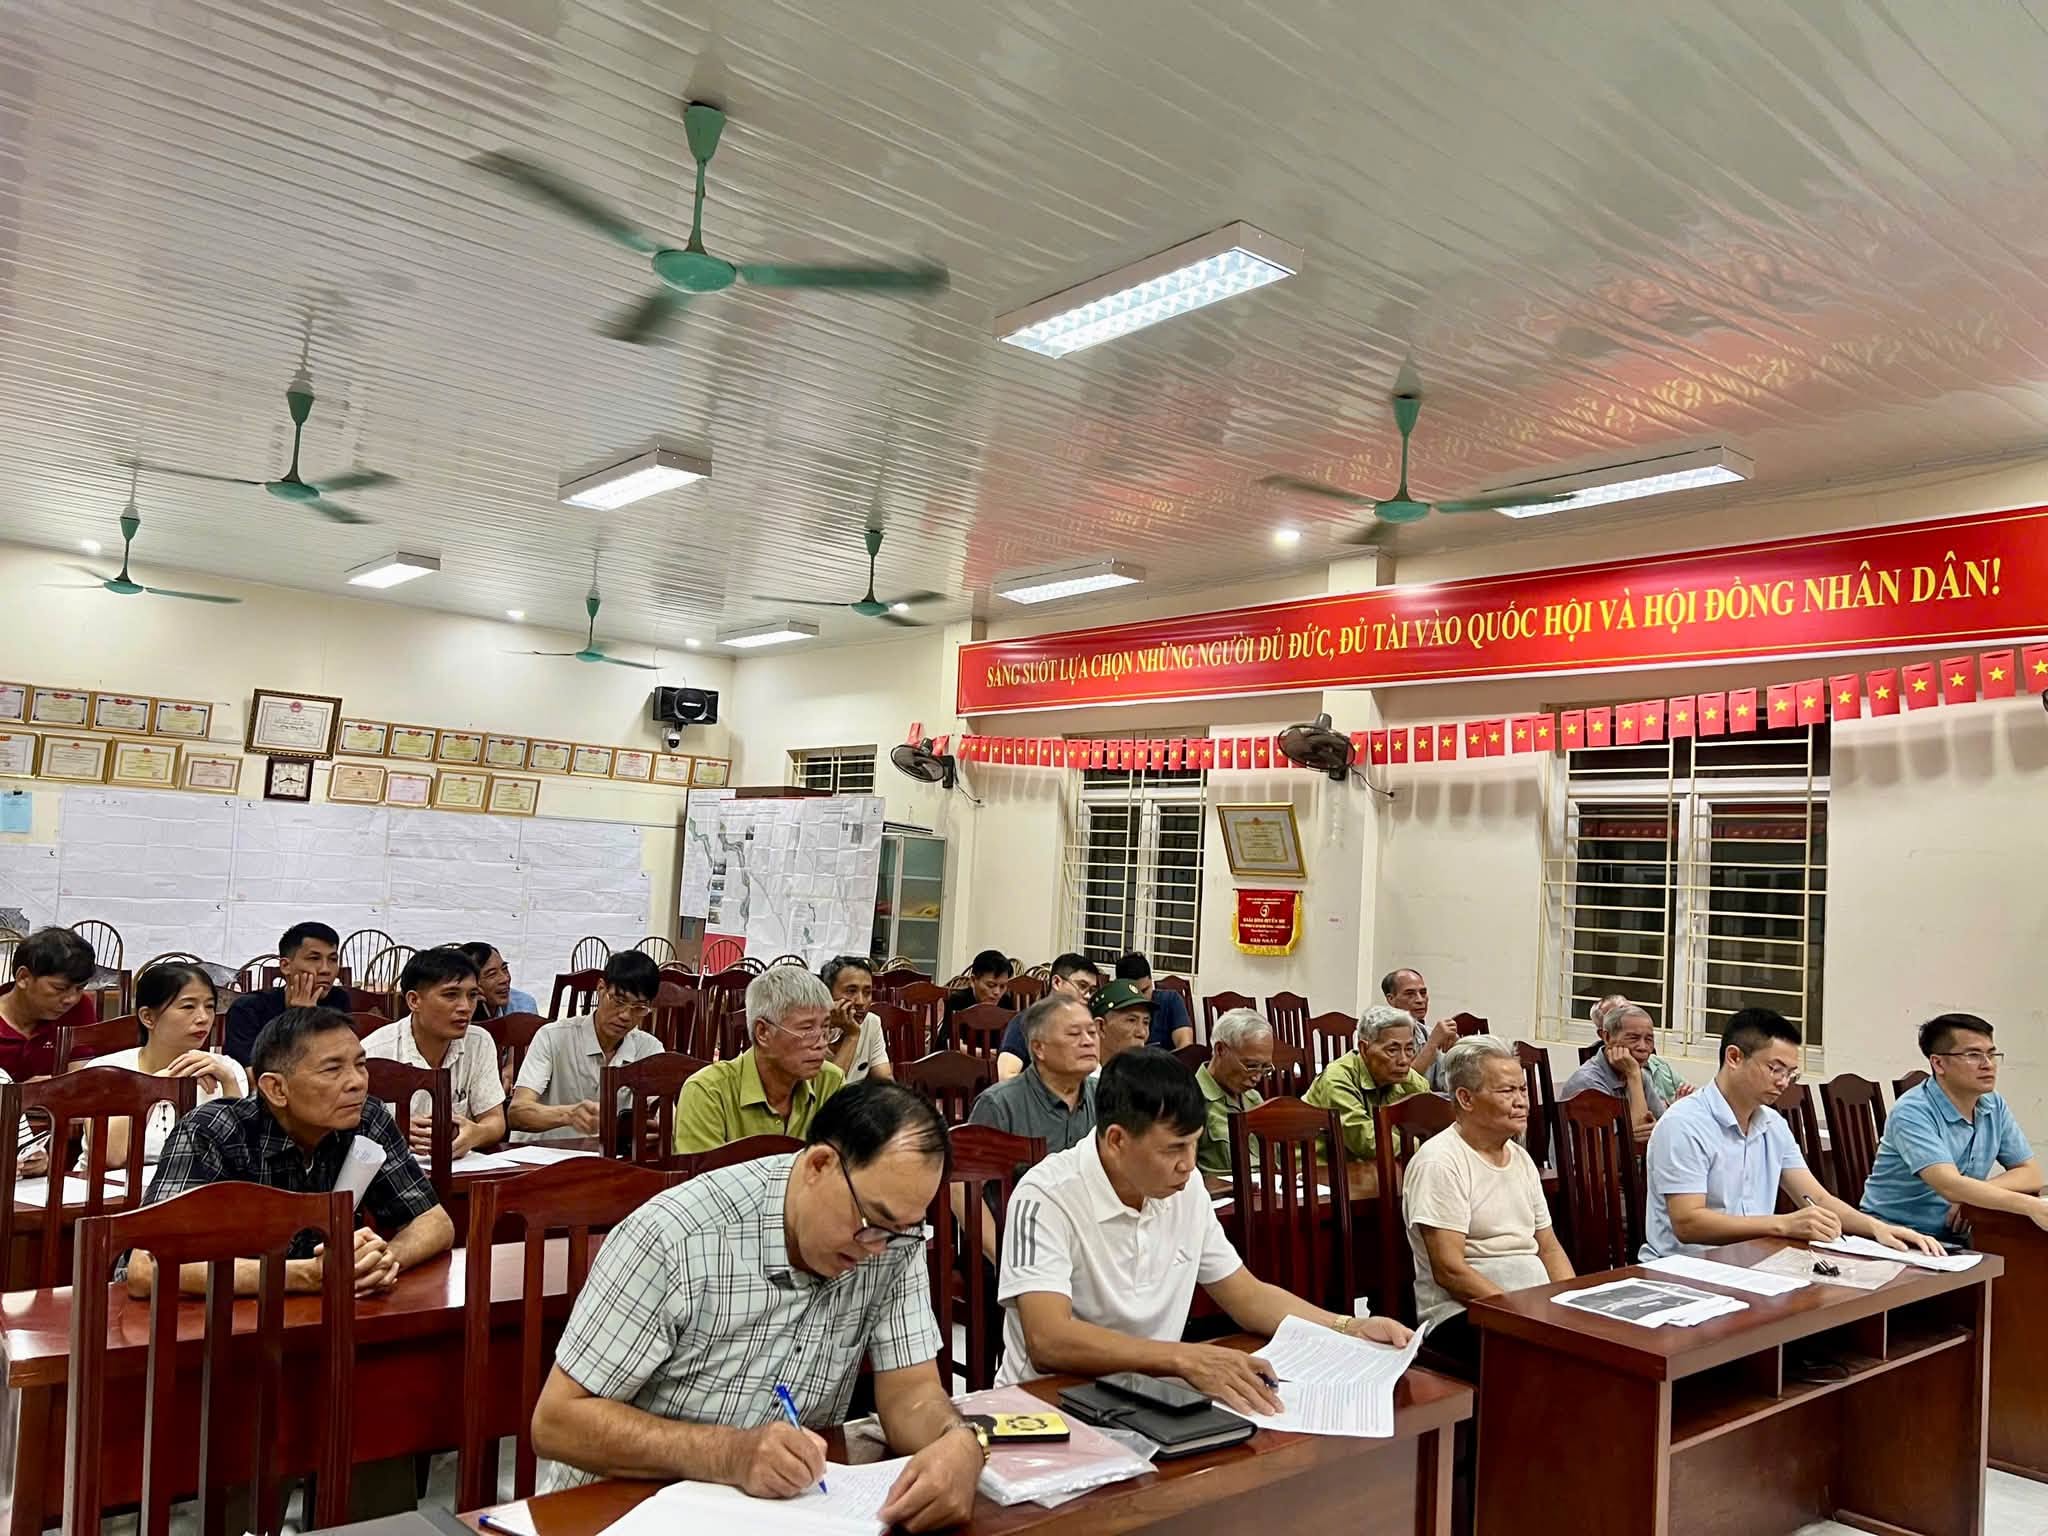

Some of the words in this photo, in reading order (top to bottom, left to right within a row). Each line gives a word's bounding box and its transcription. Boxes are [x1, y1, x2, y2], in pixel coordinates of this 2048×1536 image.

[987, 659, 1020, 688] SÁNG
[1022, 653, 1057, 684] SUỐT
[1060, 652, 1088, 686] LỰA
[1091, 650, 1133, 682] CHỌN
[1136, 641, 1193, 673] NHỮNG
[1198, 631, 1255, 667] NGƯỜI
[1258, 626, 1284, 662] ĐỦ
[1288, 622, 1334, 661] ĐỨC,
[1338, 616, 1368, 655] ĐỦ
[1372, 613, 1408, 651] TÀI
[1415, 608, 1462, 648] VÀO
[1467, 600, 1538, 649] QUỐC
[1543, 597, 1593, 643] HỘI
[1599, 587, 1636, 632] VÀ
[1643, 587, 1697, 634] HỘI
[1703, 575, 1795, 622] ĐỒNG
[1802, 560, 1902, 613] NHÂN
[1908, 550, 2001, 604] DÂN!
